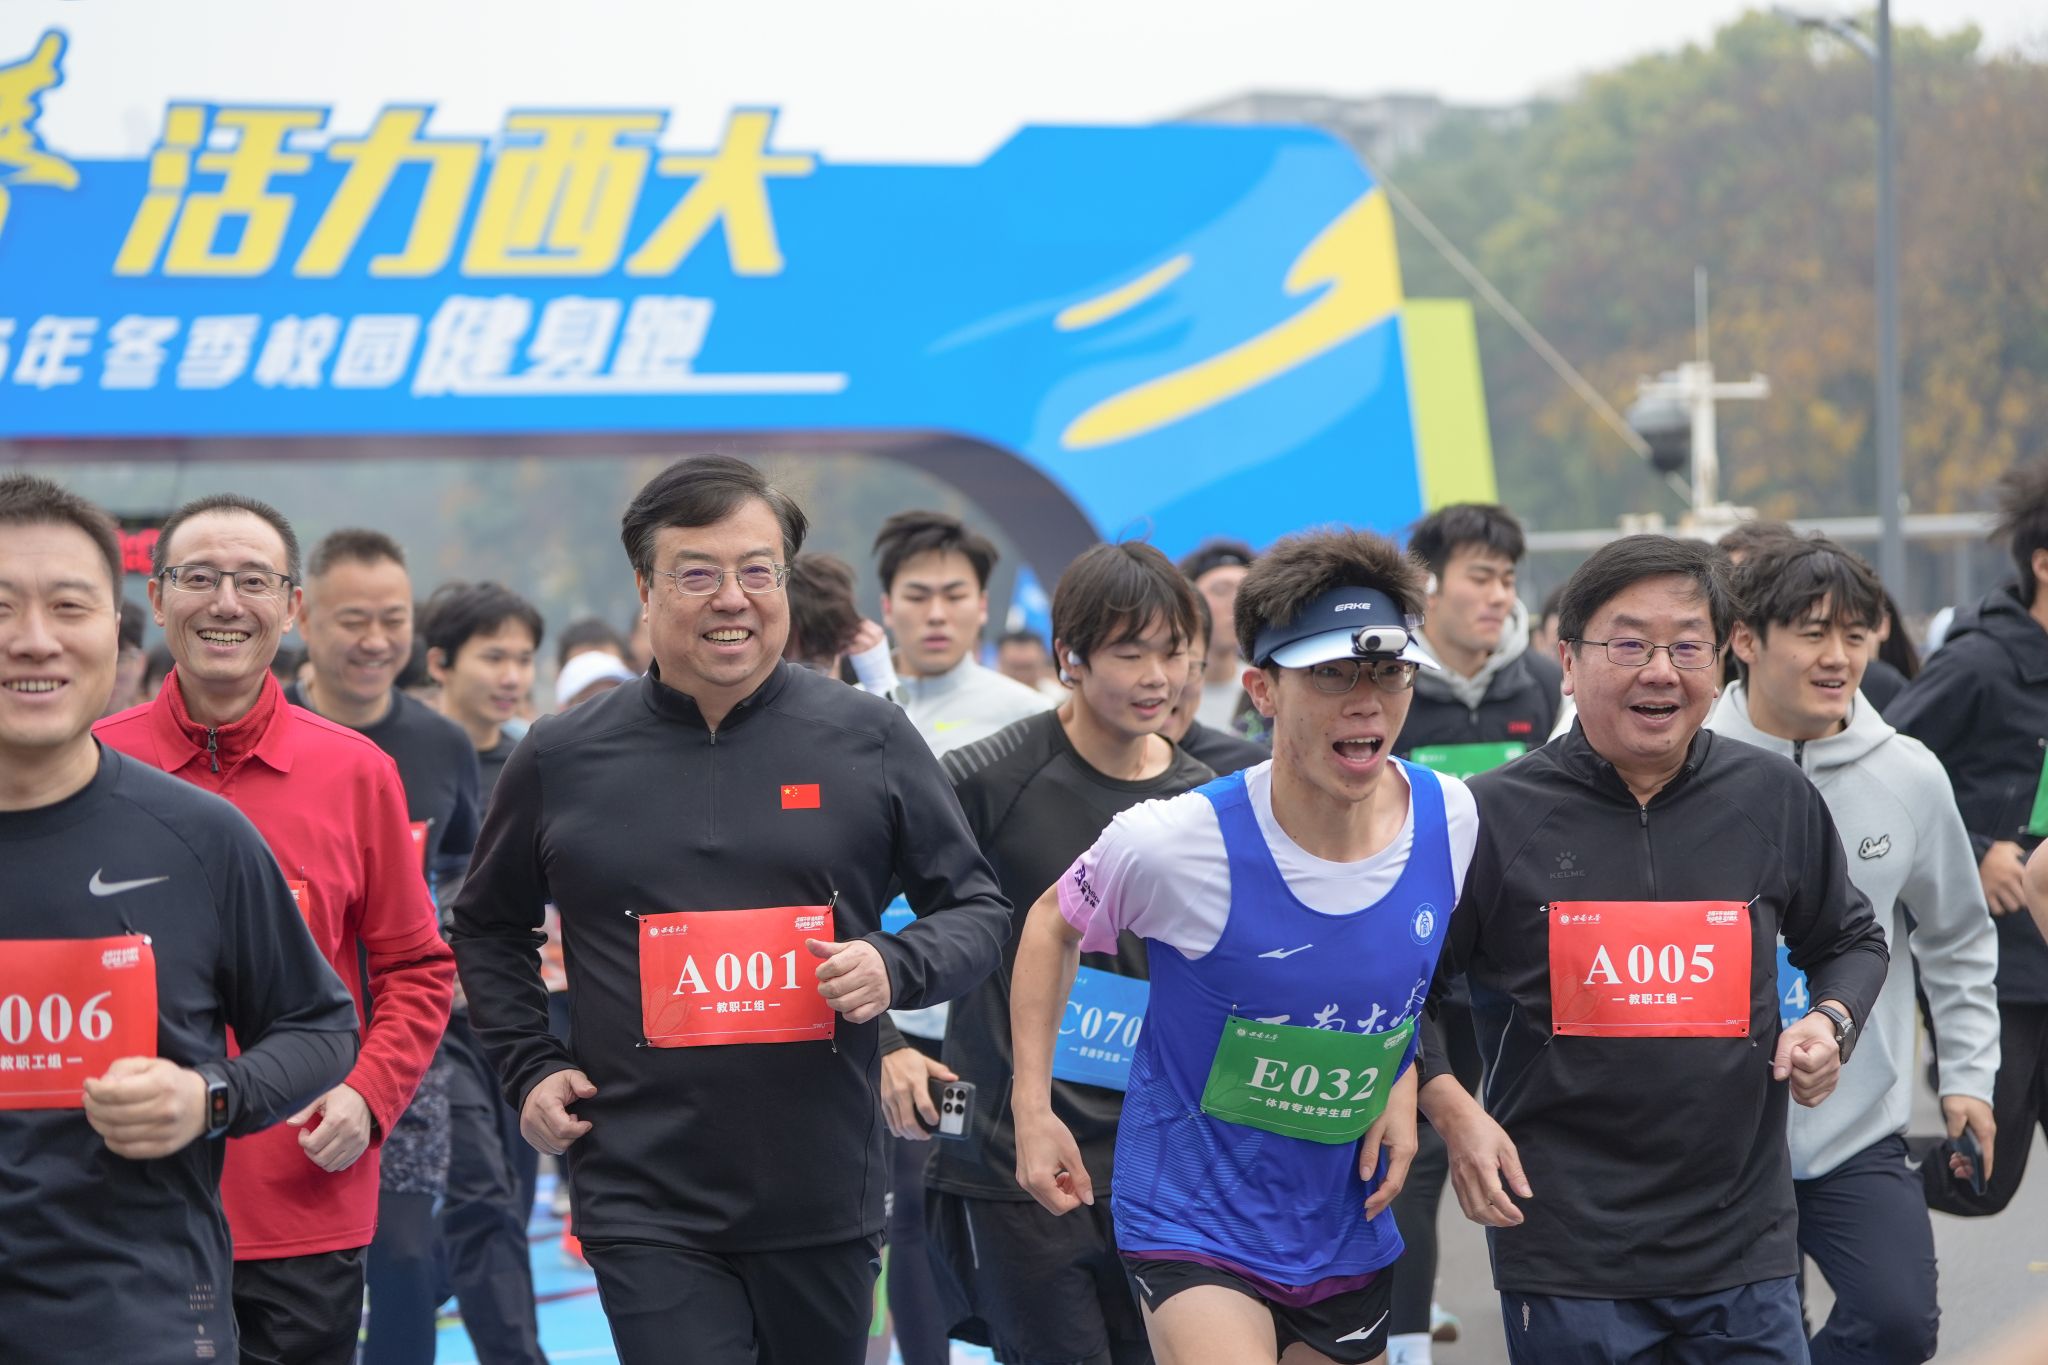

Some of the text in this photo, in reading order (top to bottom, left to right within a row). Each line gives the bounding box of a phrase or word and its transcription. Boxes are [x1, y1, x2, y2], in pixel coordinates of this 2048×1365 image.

[113, 104, 822, 276] 活力西大
[1334, 602, 1371, 612] ERKE
[1549, 870, 1586, 879] KELME
[672, 949, 802, 995] A001
[1583, 944, 1715, 985] A005
[716, 1000, 766, 1013] 教职工组
[1628, 993, 1678, 1005] 教职工组
[0, 991, 113, 1045] 006
[0, 1053, 62, 1071] 教职工组
[1245, 1056, 1379, 1101] E032
[1265, 1097, 1352, 1118] 体育专业学生组
